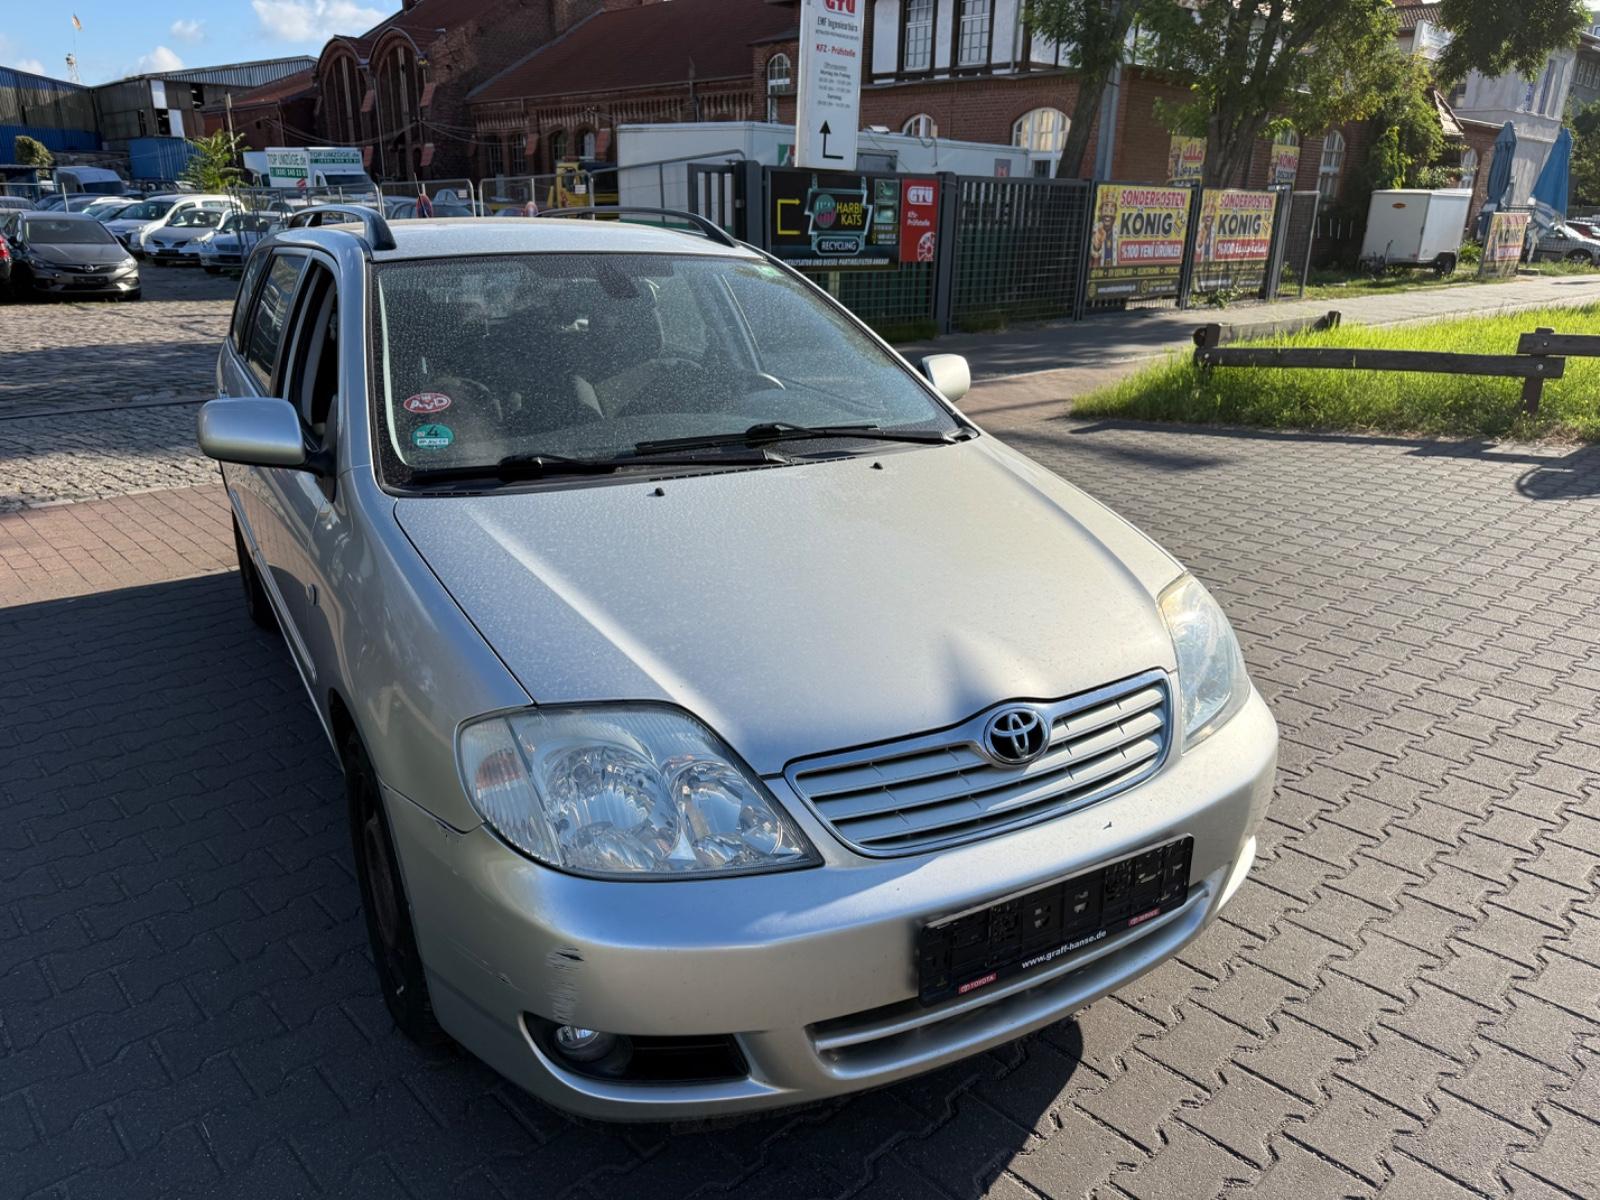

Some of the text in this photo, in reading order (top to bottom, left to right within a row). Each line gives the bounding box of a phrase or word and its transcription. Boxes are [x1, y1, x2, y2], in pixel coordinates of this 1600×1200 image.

[1120, 189, 1186, 207] SONDERPOSTEN
[1219, 193, 1274, 209] SONDERPOSTEN
[836, 202, 863, 214] HARBI
[840, 214, 862, 226] KATS
[1119, 207, 1174, 235] KÖNIG
[1217, 209, 1262, 235] KÖNIG
[821, 240, 857, 251] RECYCLING
[427, 425, 439, 436] 4
[1021, 929, 1107, 969] www.graff-hanse.de
[969, 971, 997, 990] TOYOTA
